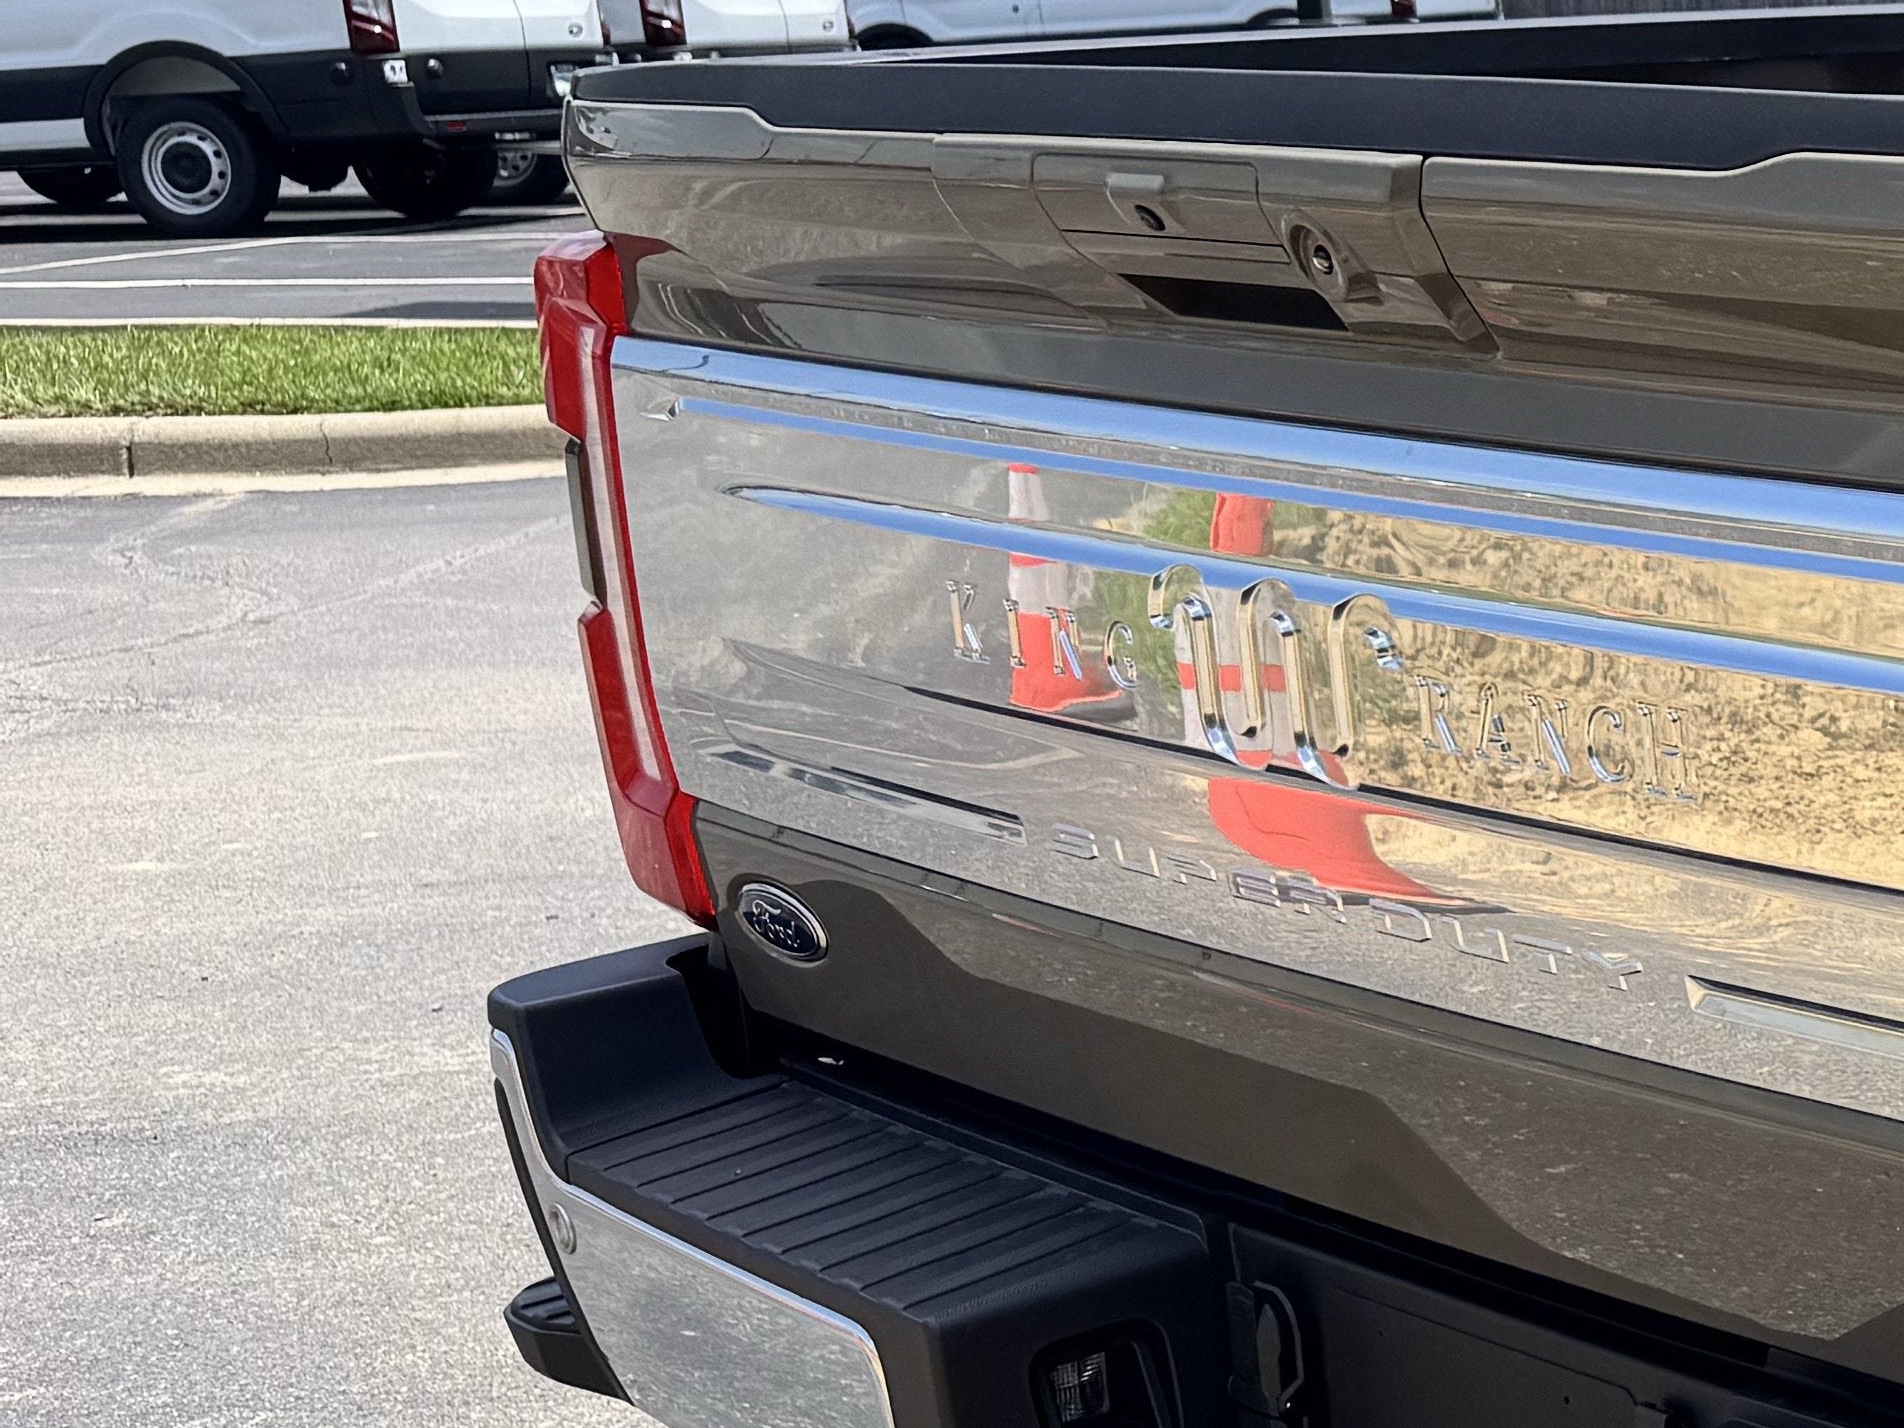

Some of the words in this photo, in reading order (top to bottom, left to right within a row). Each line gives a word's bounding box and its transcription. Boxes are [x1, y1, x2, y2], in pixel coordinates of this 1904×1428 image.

[945, 579, 1140, 693] KING
[1413, 673, 1699, 804] RANCH
[1049, 822, 1347, 925] SUPER
[1369, 896, 1644, 992] DUTY
